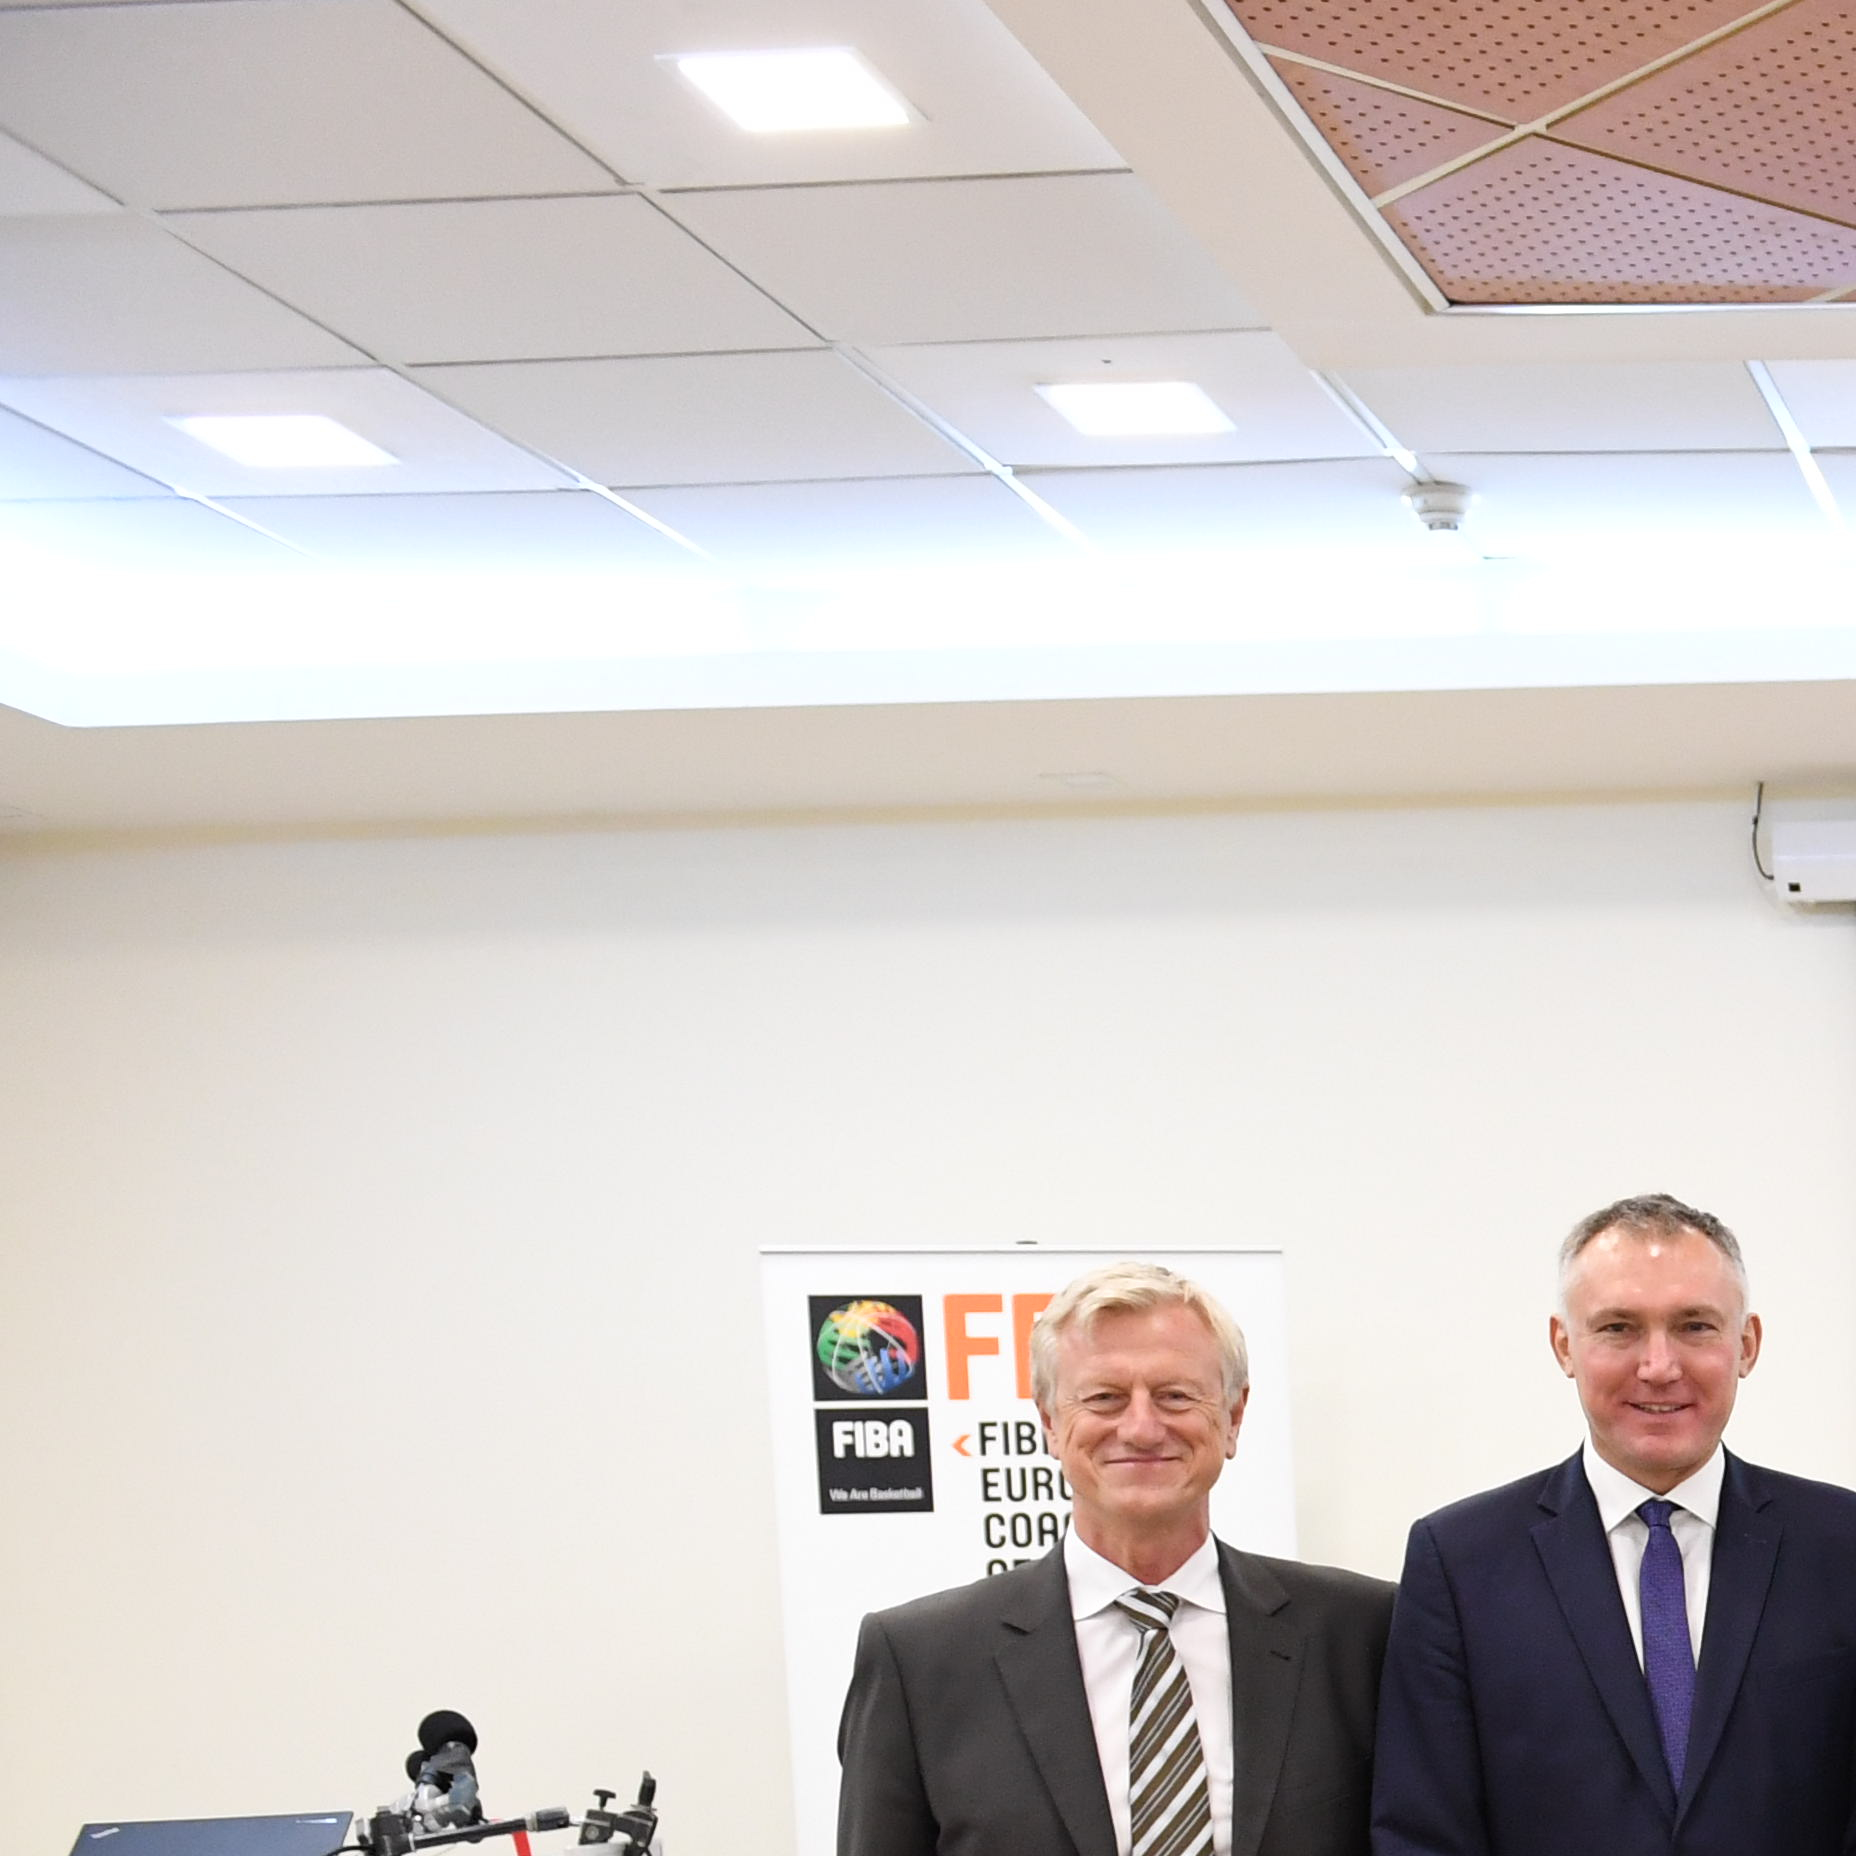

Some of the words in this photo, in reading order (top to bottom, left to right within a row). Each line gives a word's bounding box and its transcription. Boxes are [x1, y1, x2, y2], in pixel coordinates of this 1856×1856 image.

[832, 1419, 915, 1458] FIBA
[829, 1488, 848, 1501] We
[849, 1488, 868, 1501] Are
[870, 1487, 924, 1501] Basketball
[984, 1512, 1071, 1549] COA
